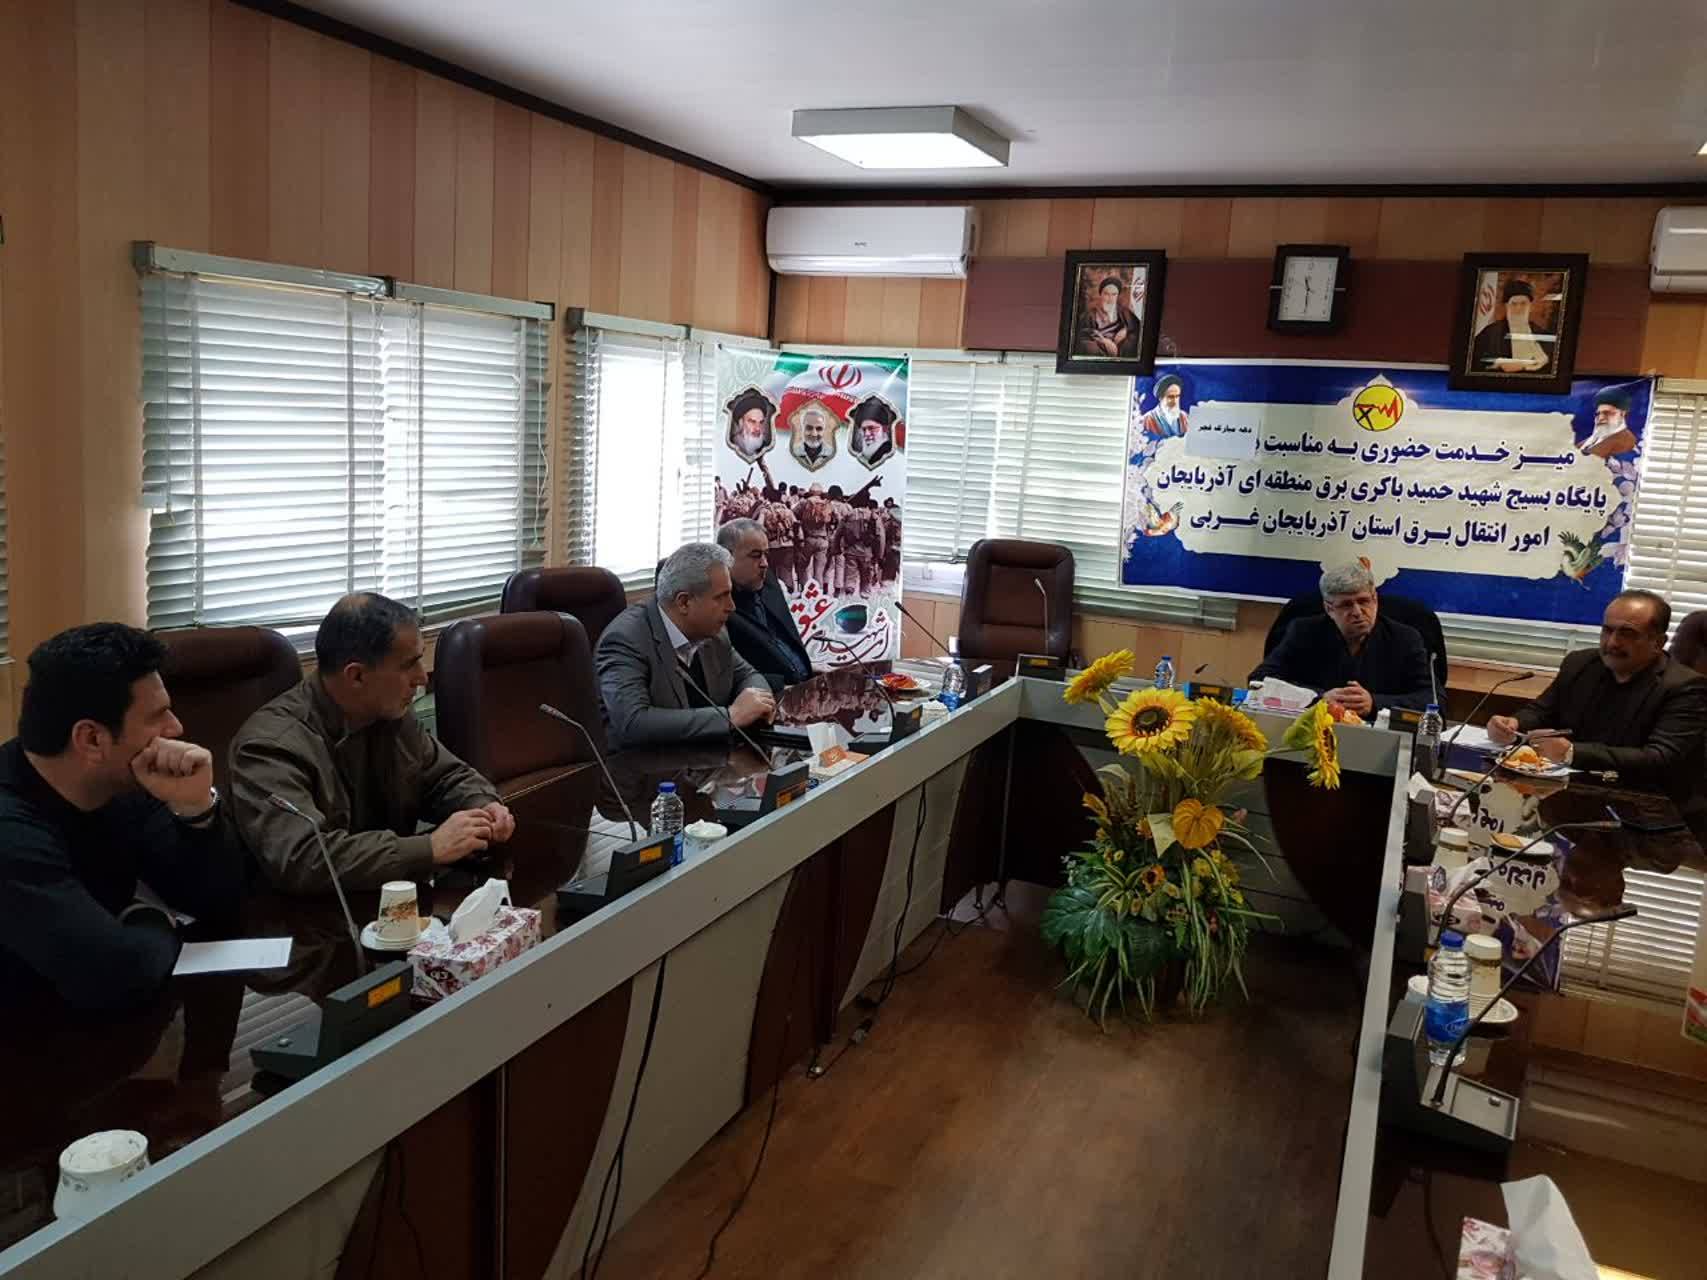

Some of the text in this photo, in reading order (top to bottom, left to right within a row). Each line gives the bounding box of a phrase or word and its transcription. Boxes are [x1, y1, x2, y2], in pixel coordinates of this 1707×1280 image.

[1214, 424, 1236, 434] مبارک
[1264, 432, 1323, 456] مناسبت
[1327, 438, 1358, 460] به
[1361, 438, 1431, 463] حضوری
[1435, 441, 1510, 461] خدمت
[1512, 446, 1575, 470] میز
[1157, 464, 1607, 516] پایگاه بسیج شهید حمید باکری برق منطقه ای آذربایجان
[1190, 507, 1550, 552] امور انتقال برق استان آذربایجان غربی
